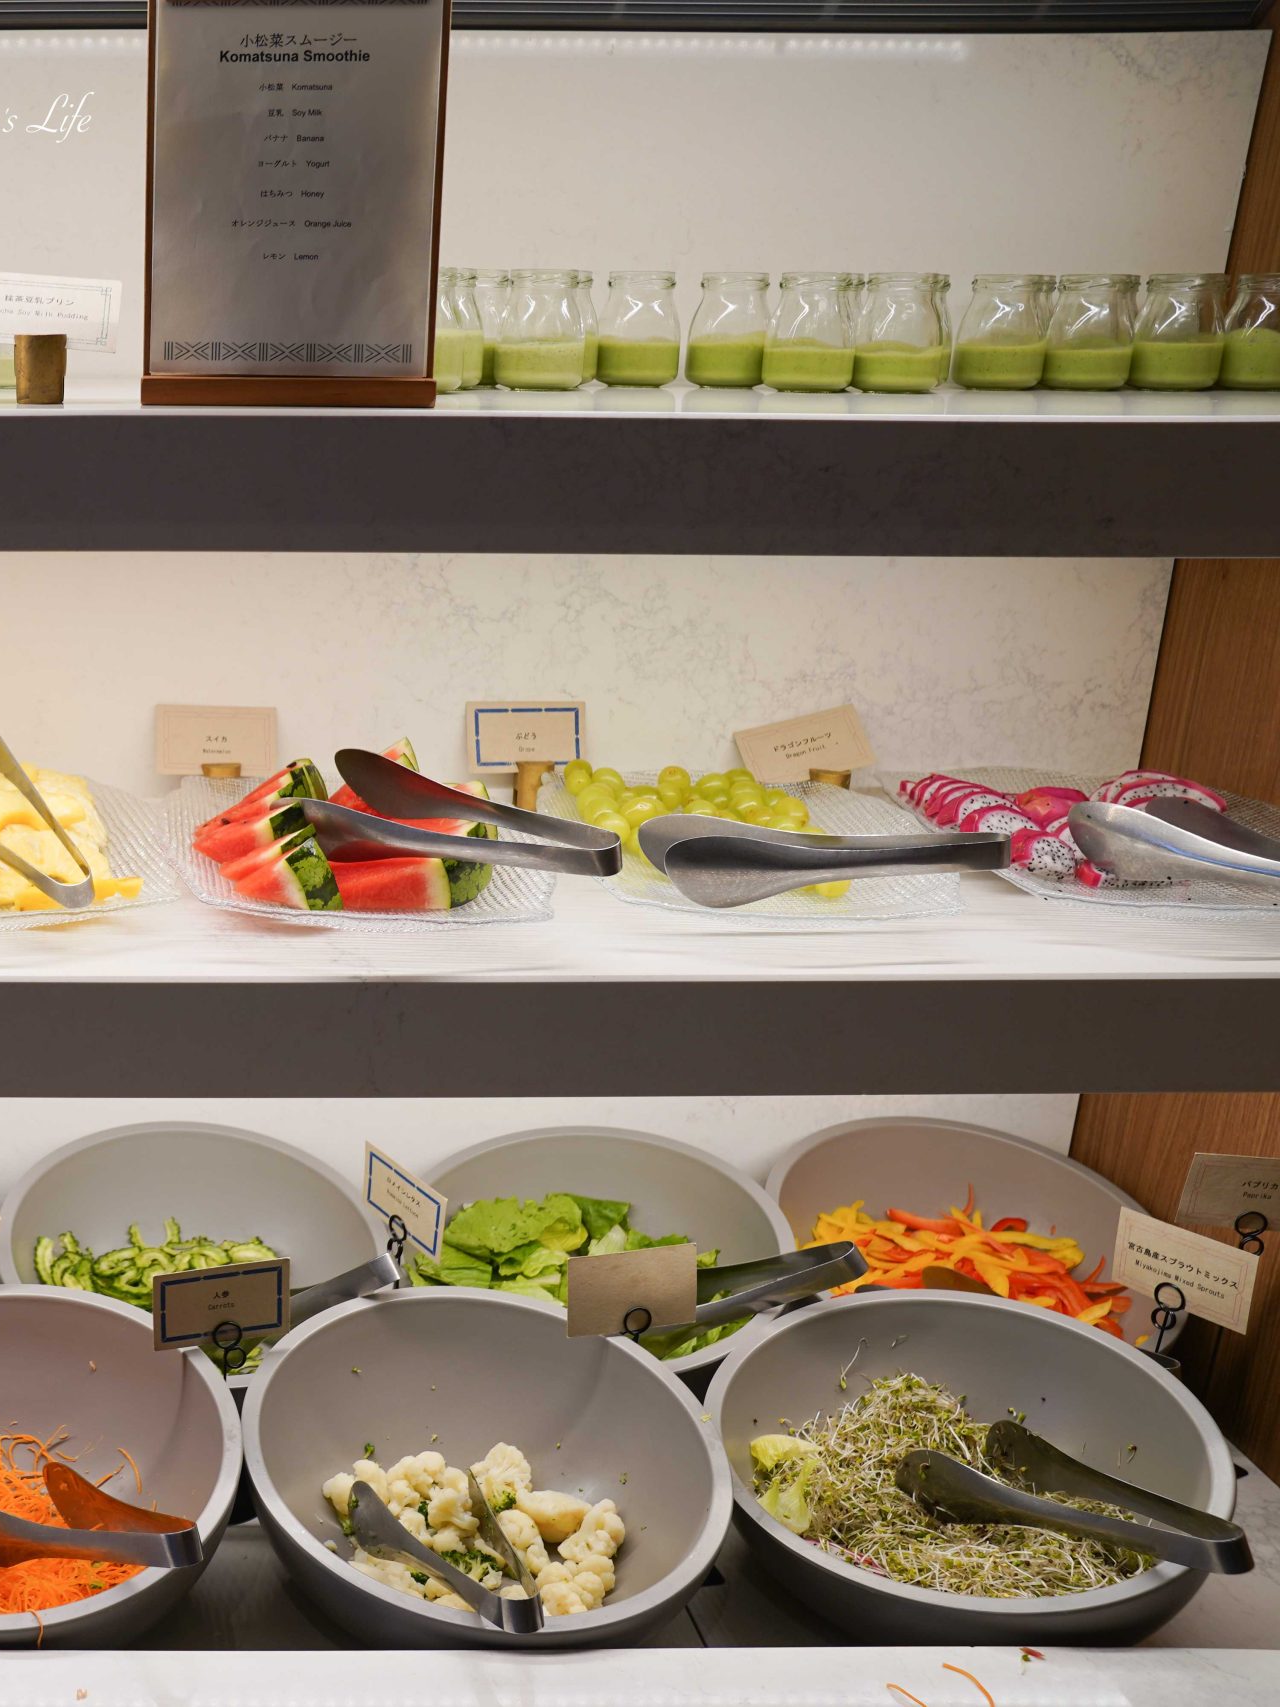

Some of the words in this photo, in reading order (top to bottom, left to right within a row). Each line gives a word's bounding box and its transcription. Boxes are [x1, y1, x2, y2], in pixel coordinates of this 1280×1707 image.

[240, 32, 357, 48] 小松菜スムージー
[219, 50, 299, 63] Komatsuna
[303, 50, 370, 63] Smoothie
[259, 83, 283, 91] 小松菜
[291, 83, 333, 91] Komatsuna
[268, 109, 284, 118] 豆乳
[291, 109, 306, 118] Soy
[307, 109, 322, 117] Milk
[263, 134, 288, 142] バナナ
[296, 134, 324, 142] Banana
[258, 160, 297, 168] ヨーグルト
[306, 160, 330, 169] Yogurt
[260, 189, 293, 198] はちみつ
[300, 190, 324, 198] Honey
[232, 219, 295, 227] オレンジジュース
[304, 219, 331, 228] Orange
[332, 219, 352, 228] Juice
[294, 253, 319, 261] Lemon
[205, 735, 228, 743] スイカ
[515, 732, 537, 740] ぶどう
[773, 731, 832, 752] ドラゴンフルーツ
[1243, 1191, 1272, 1200] Paprika
[1127, 1241, 1239, 1290] 宮古島産スプラウトミックス
[1135, 1258, 1172, 1279] Miyakojima
[1174, 1274, 1195, 1288] Mixed
[1197, 1283, 1225, 1299] Sprouts
[208, 1302, 235, 1310] Carrots
